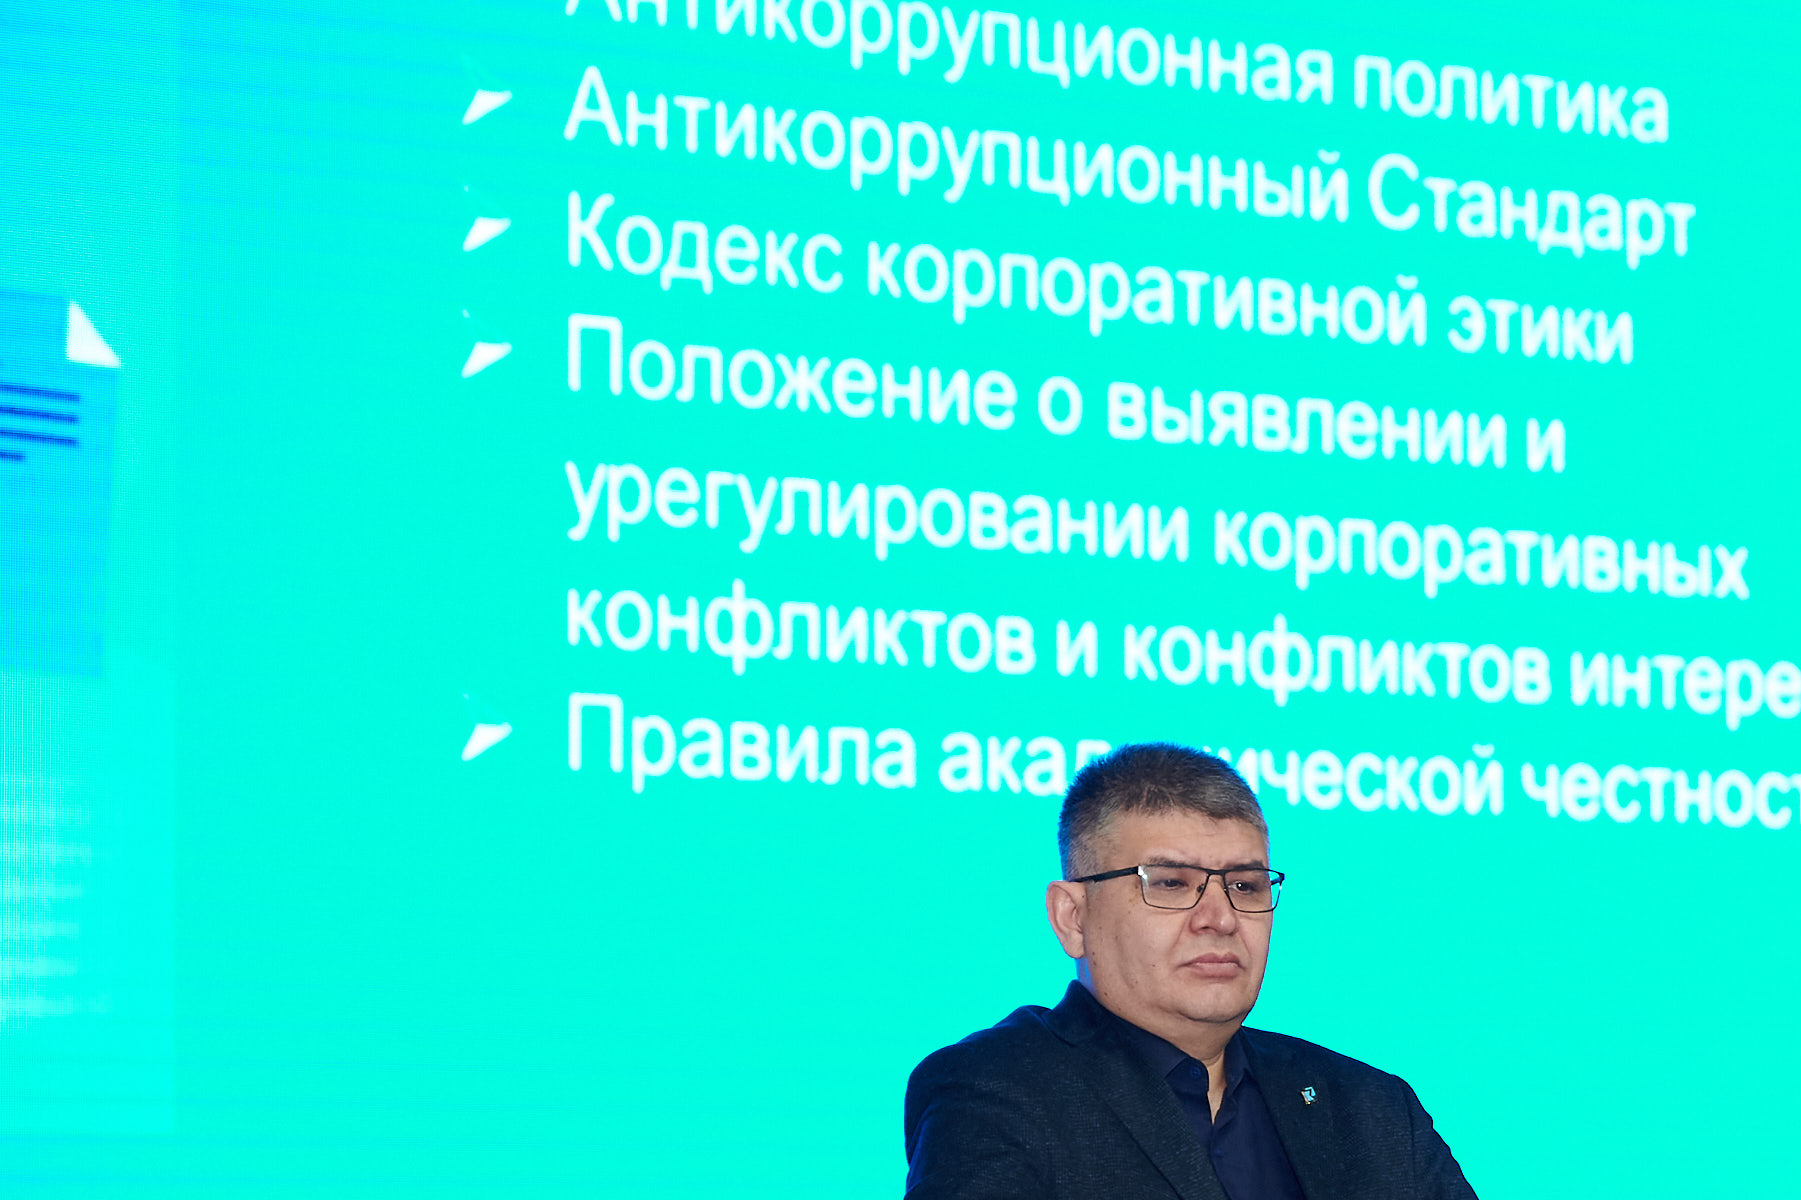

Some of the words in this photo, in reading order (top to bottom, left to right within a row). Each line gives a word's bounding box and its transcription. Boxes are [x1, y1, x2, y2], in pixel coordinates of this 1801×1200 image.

[562, 64, 1350, 224] Антикоррупционный
[1366, 152, 1698, 270] Стандарт
[1352, 53, 1670, 145] политика
[566, 189, 844, 293] Кодекс
[866, 240, 1428, 348] корпоративной
[1446, 293, 1635, 365] этики
[566, 311, 1019, 431] Положение
[1036, 374, 1084, 437] о
[1106, 380, 1508, 470] выявлении
[1525, 416, 1567, 475] и
[563, 459, 1190, 563] урегулировании
[1213, 508, 1751, 602] корпоративных
[565, 577, 1038, 676] конфликтов
[1054, 618, 1099, 679] и
[1122, 612, 1553, 708] конфликтов
[567, 690, 918, 795] Правила
[937, 730, 1505, 817] акаической
